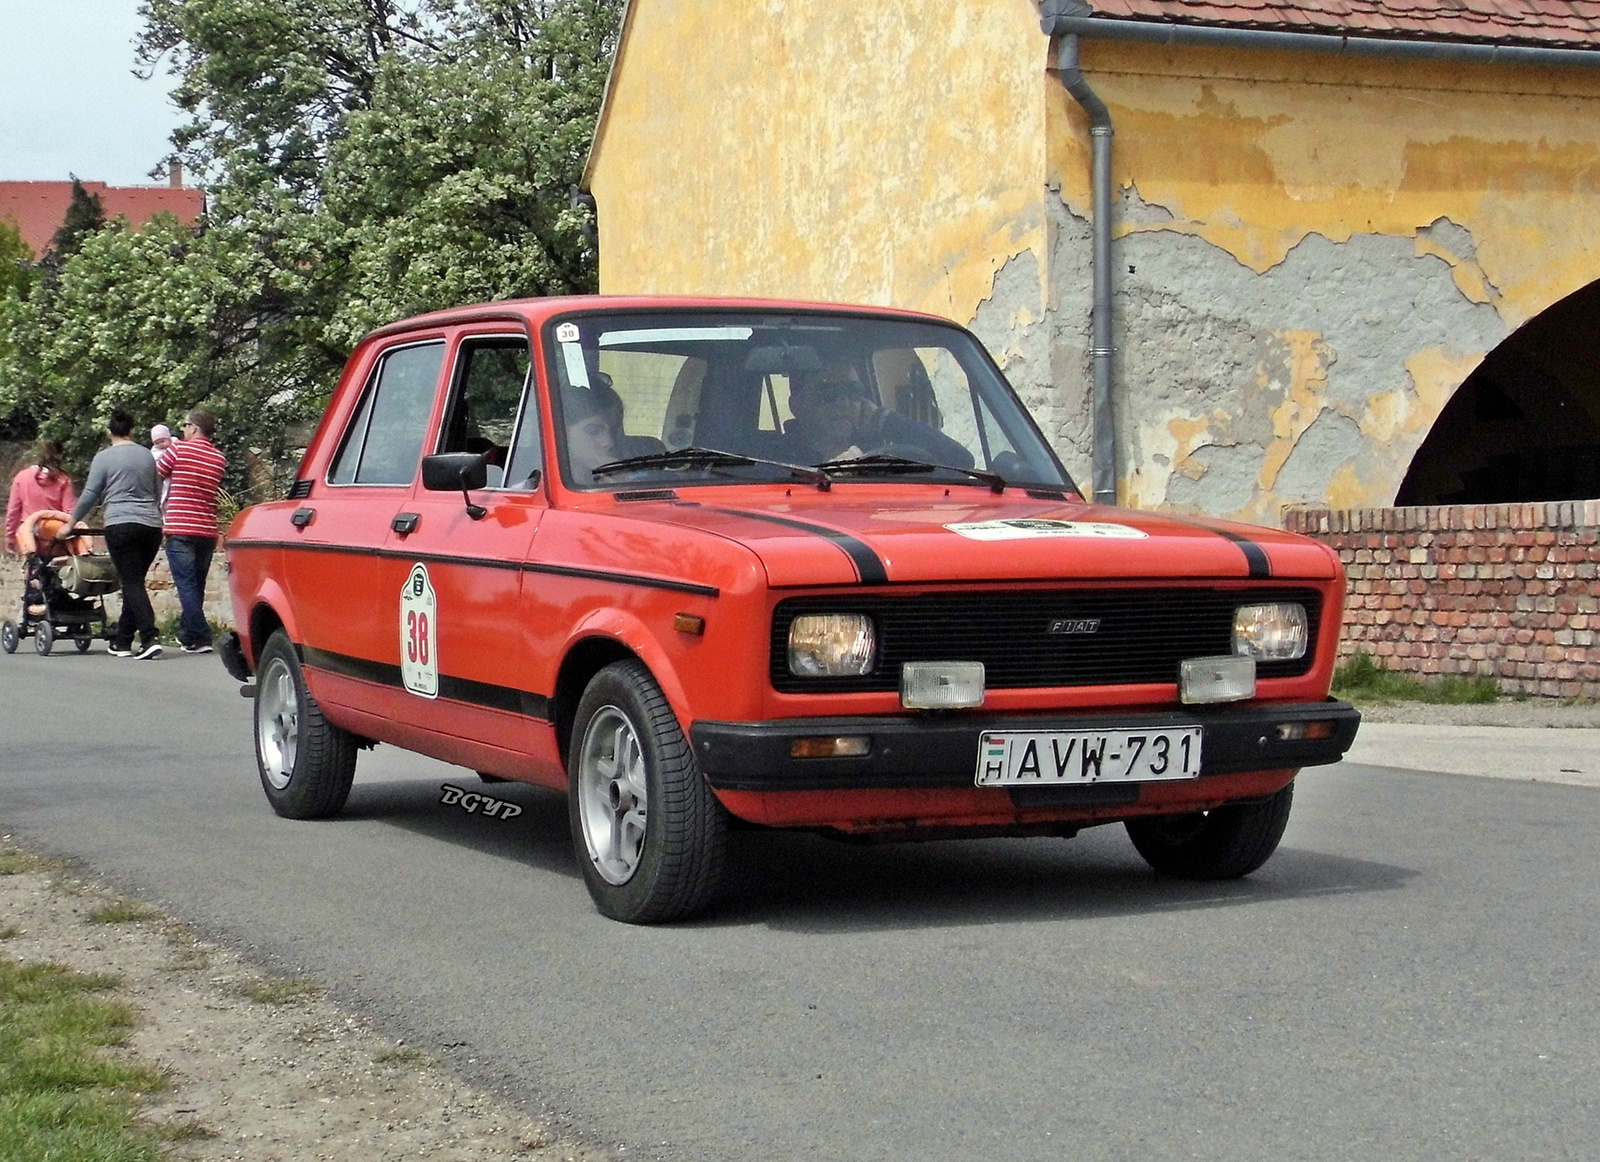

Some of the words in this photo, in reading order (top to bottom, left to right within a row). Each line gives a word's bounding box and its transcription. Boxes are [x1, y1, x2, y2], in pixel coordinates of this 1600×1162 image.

[561, 330, 575, 338] 38
[1051, 621, 1098, 632] FIAT
[407, 609, 429, 666] 38
[1016, 734, 1192, 778] AVW-731
[985, 760, 1003, 779] H
